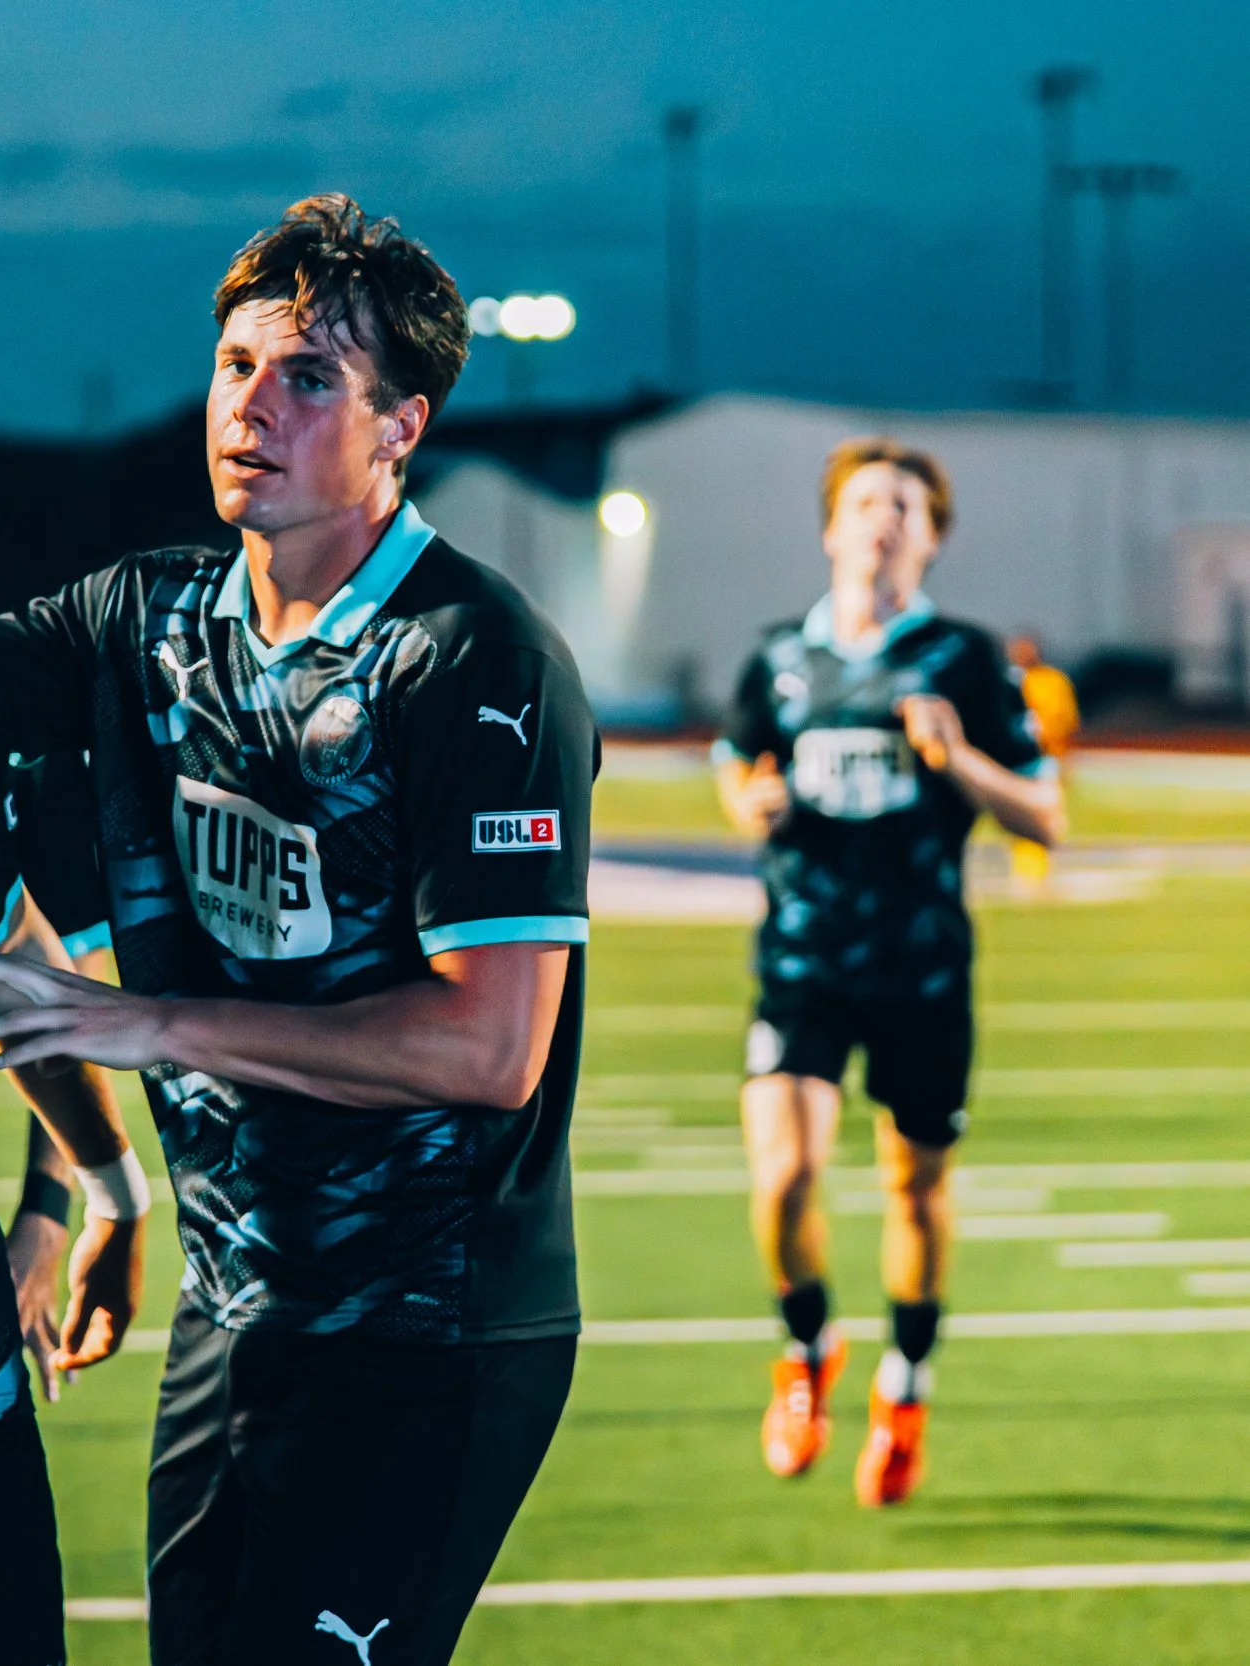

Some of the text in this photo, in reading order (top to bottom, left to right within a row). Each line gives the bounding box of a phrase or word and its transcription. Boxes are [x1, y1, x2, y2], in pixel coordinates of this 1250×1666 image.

[183, 800, 312, 911] TUPPS
[479, 819, 531, 844] USL
[198, 890, 292, 942] BREWERY
